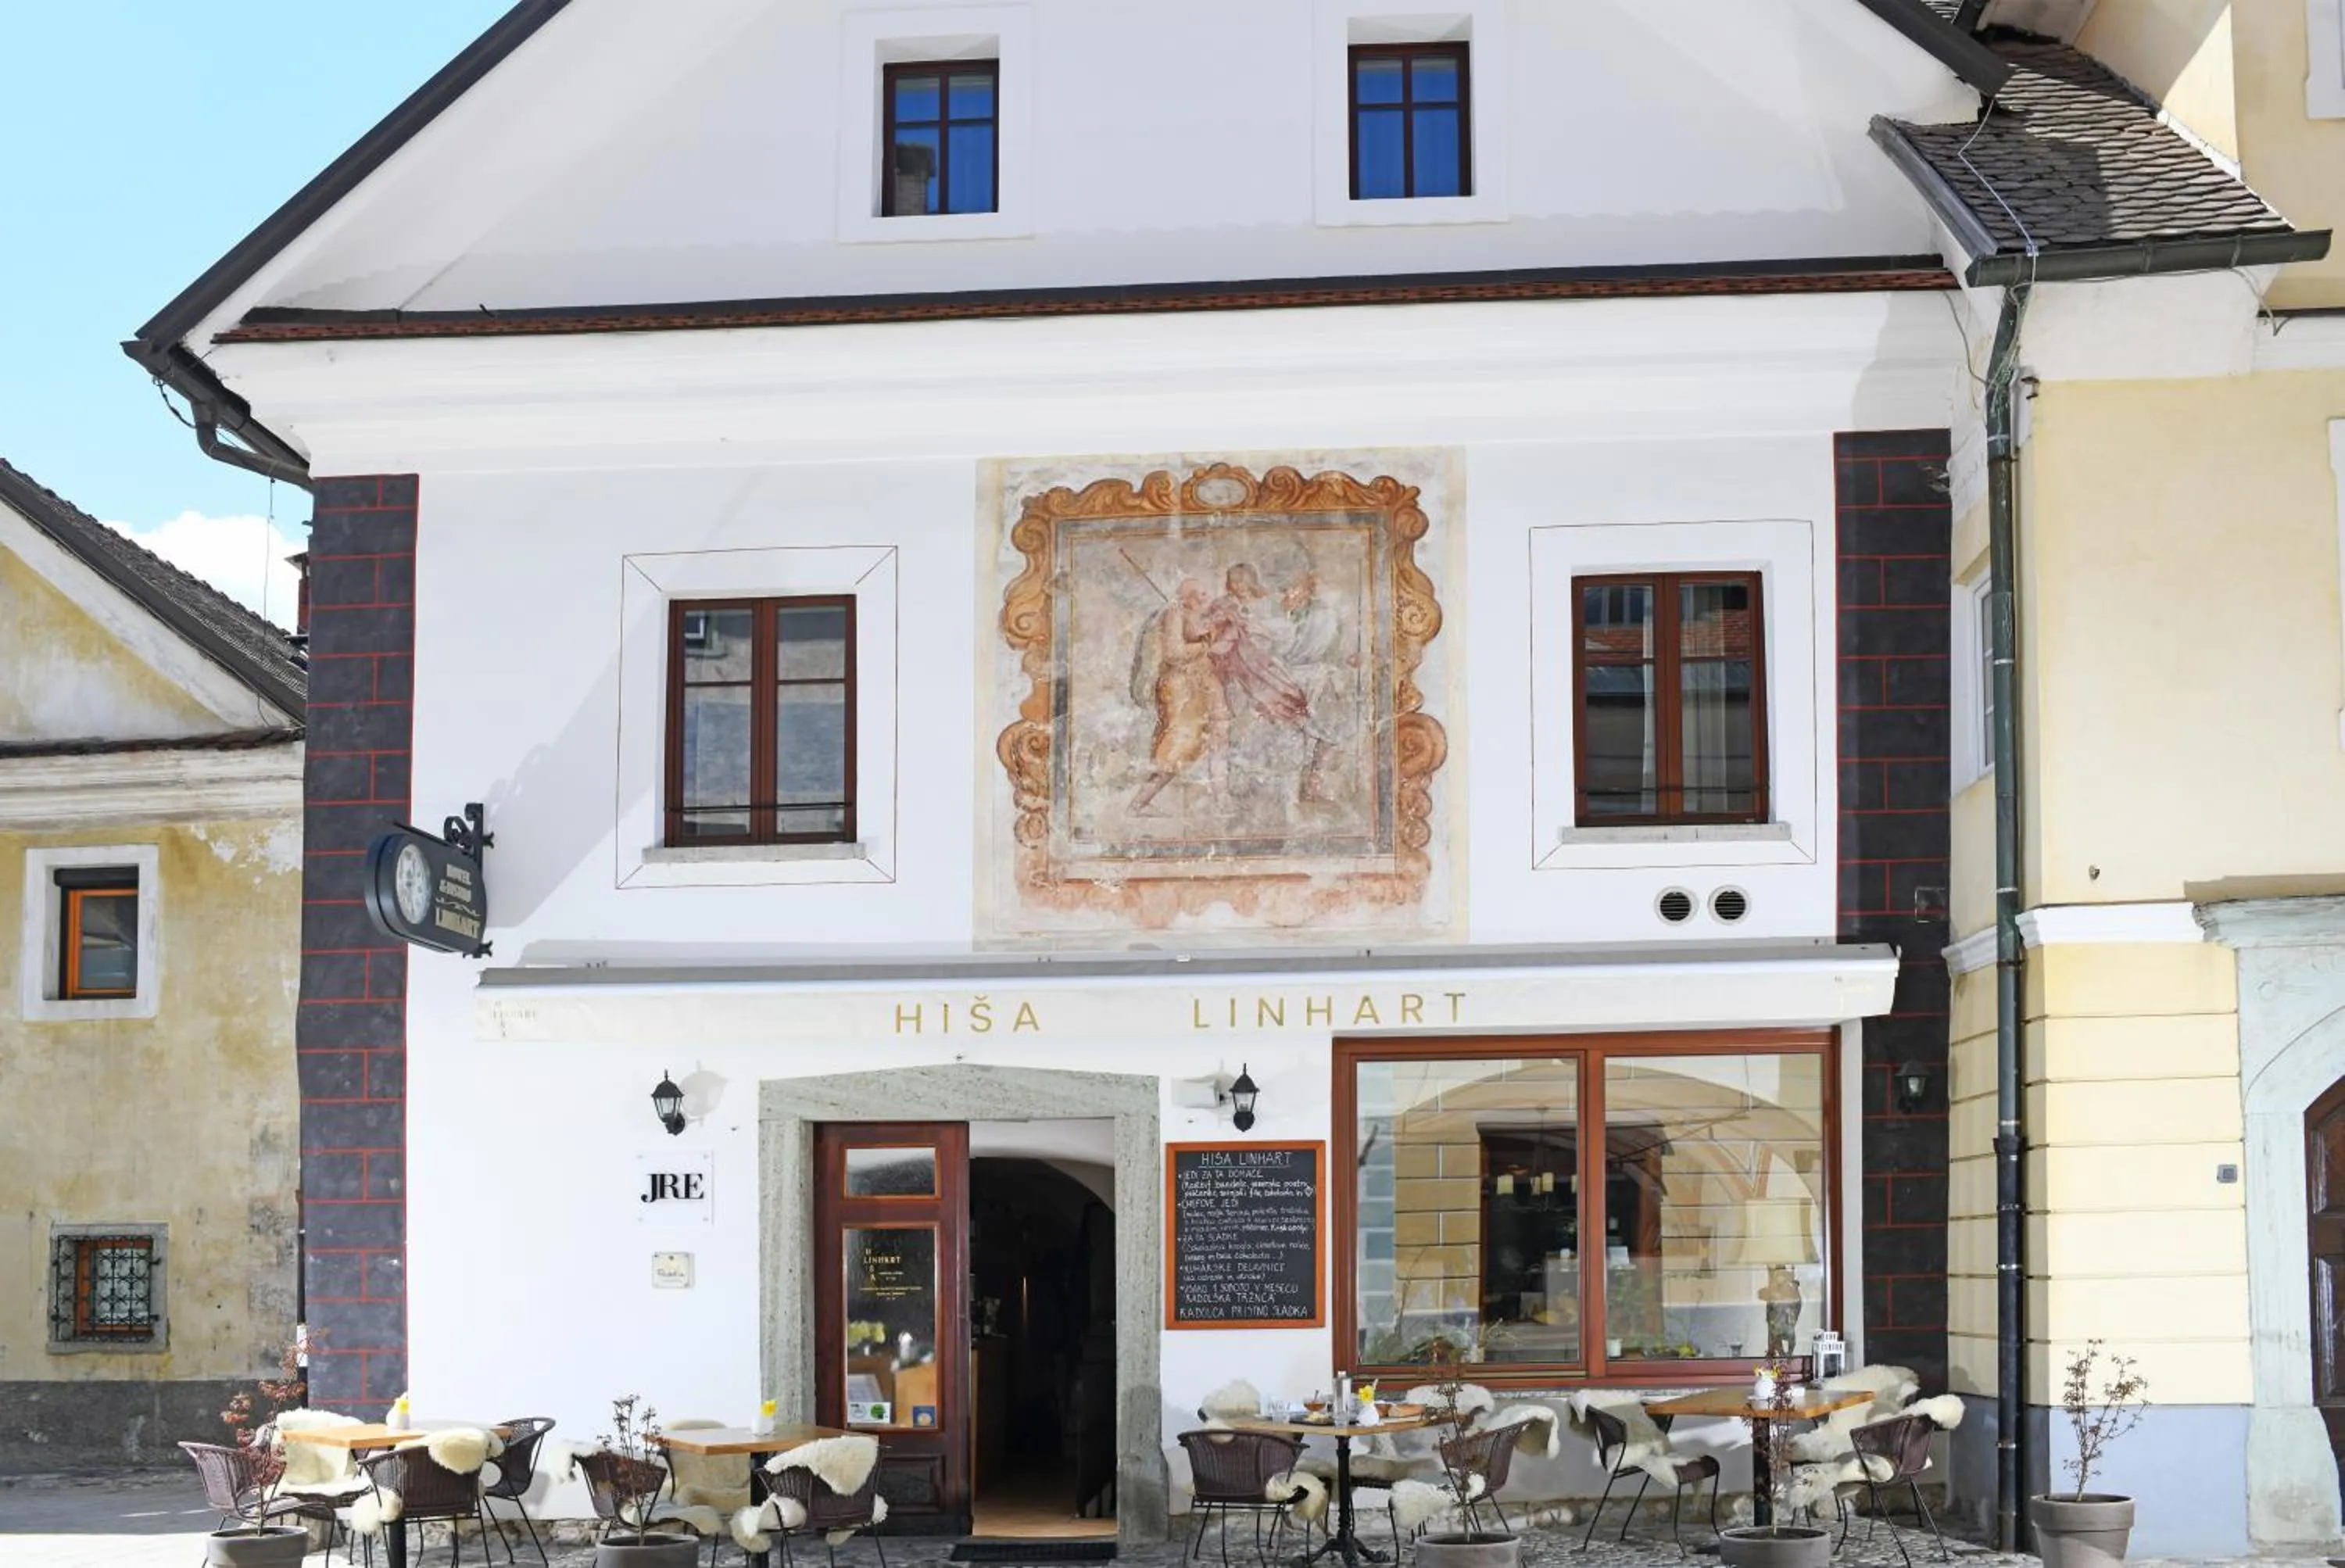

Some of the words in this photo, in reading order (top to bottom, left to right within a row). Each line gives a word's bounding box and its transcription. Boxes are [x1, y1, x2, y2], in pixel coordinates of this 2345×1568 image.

[896, 995, 1040, 1033] HIŠA
[1194, 993, 1466, 1028] LINHART
[1239, 1151, 1291, 1165] LINHART
[641, 1173, 704, 1202] JRE
